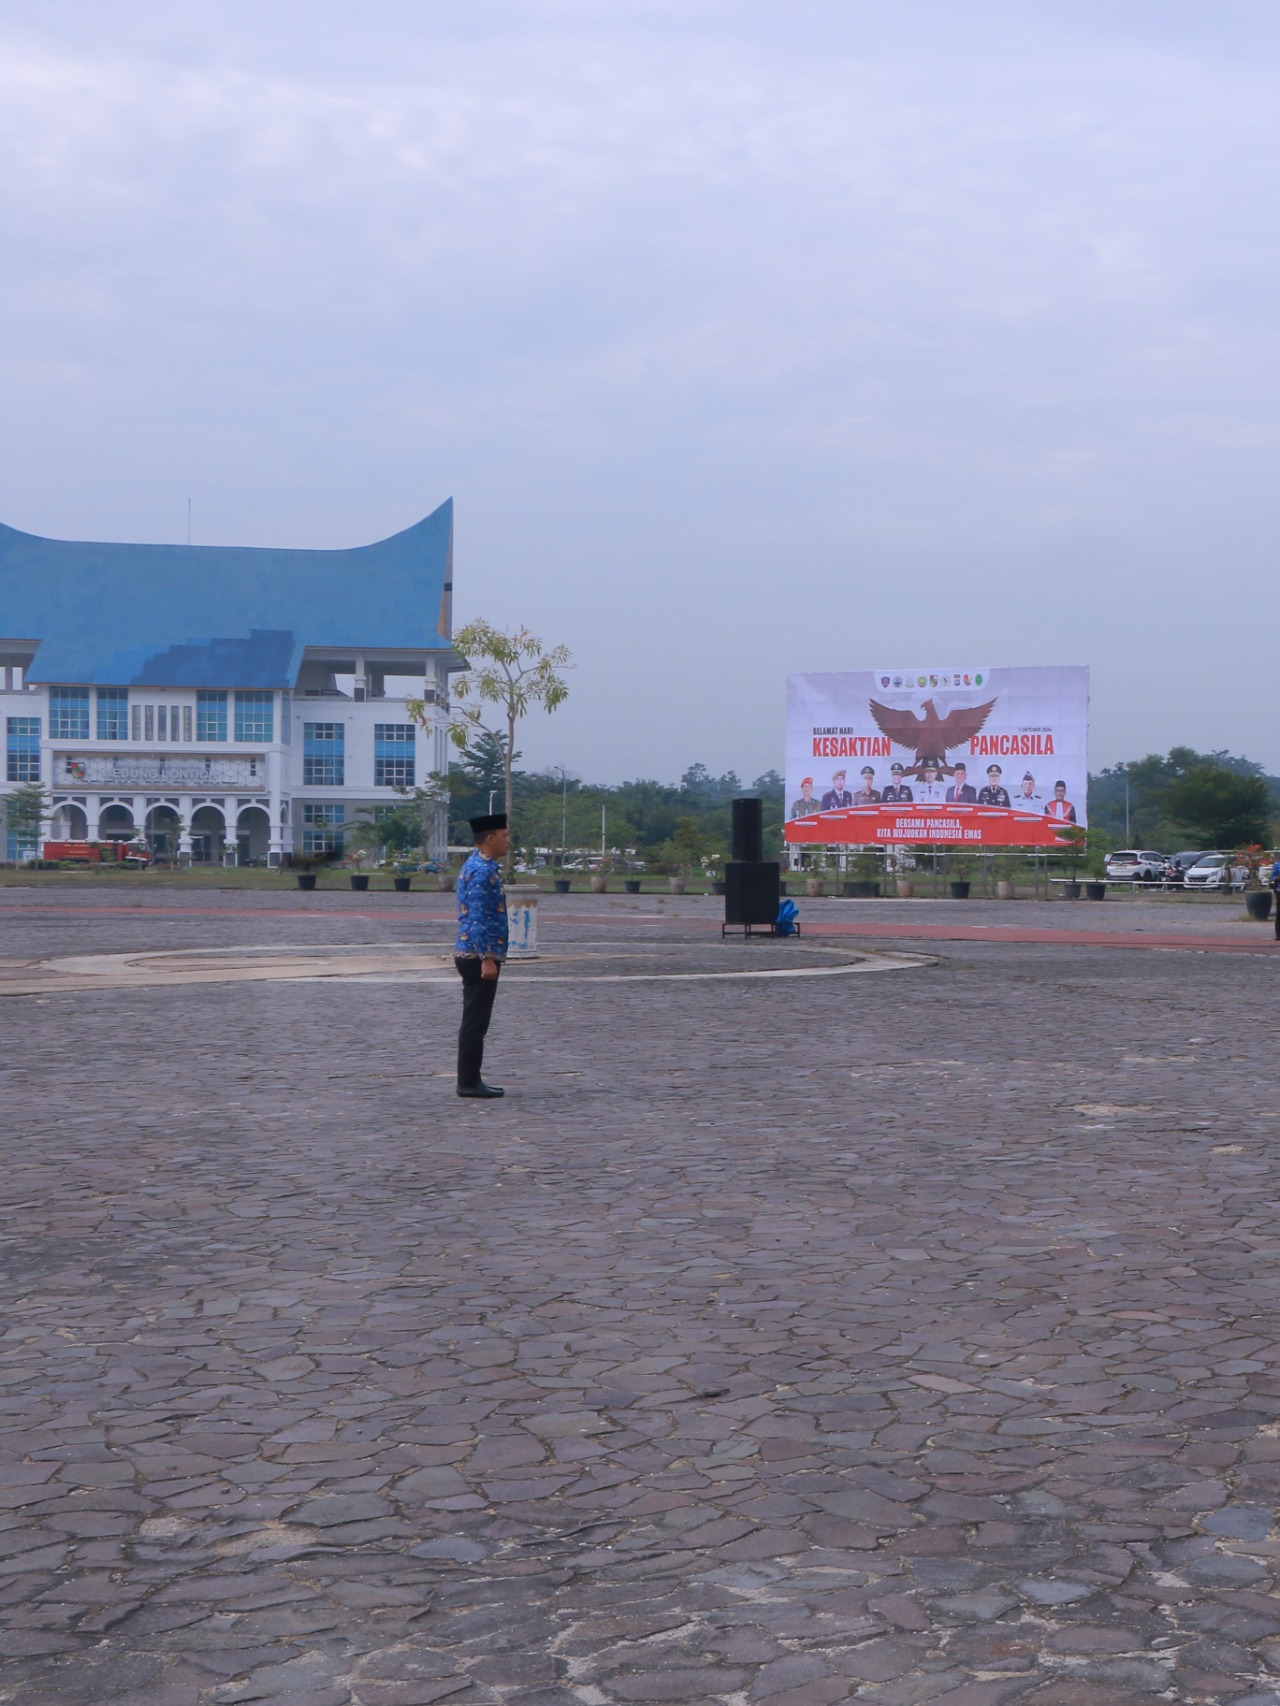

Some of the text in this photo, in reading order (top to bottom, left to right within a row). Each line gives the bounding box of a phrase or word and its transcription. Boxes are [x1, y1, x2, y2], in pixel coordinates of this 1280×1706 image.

[813, 727, 854, 735] SELAMAT HARI
[812, 737, 891, 757] KESAKTIAN
[970, 734, 1054, 756] PANCASILA
[895, 818, 963, 830] BERSAMA PANCASILA,
[876, 828, 982, 839] KITA WUJUDKAN INDONESIA EMAS
